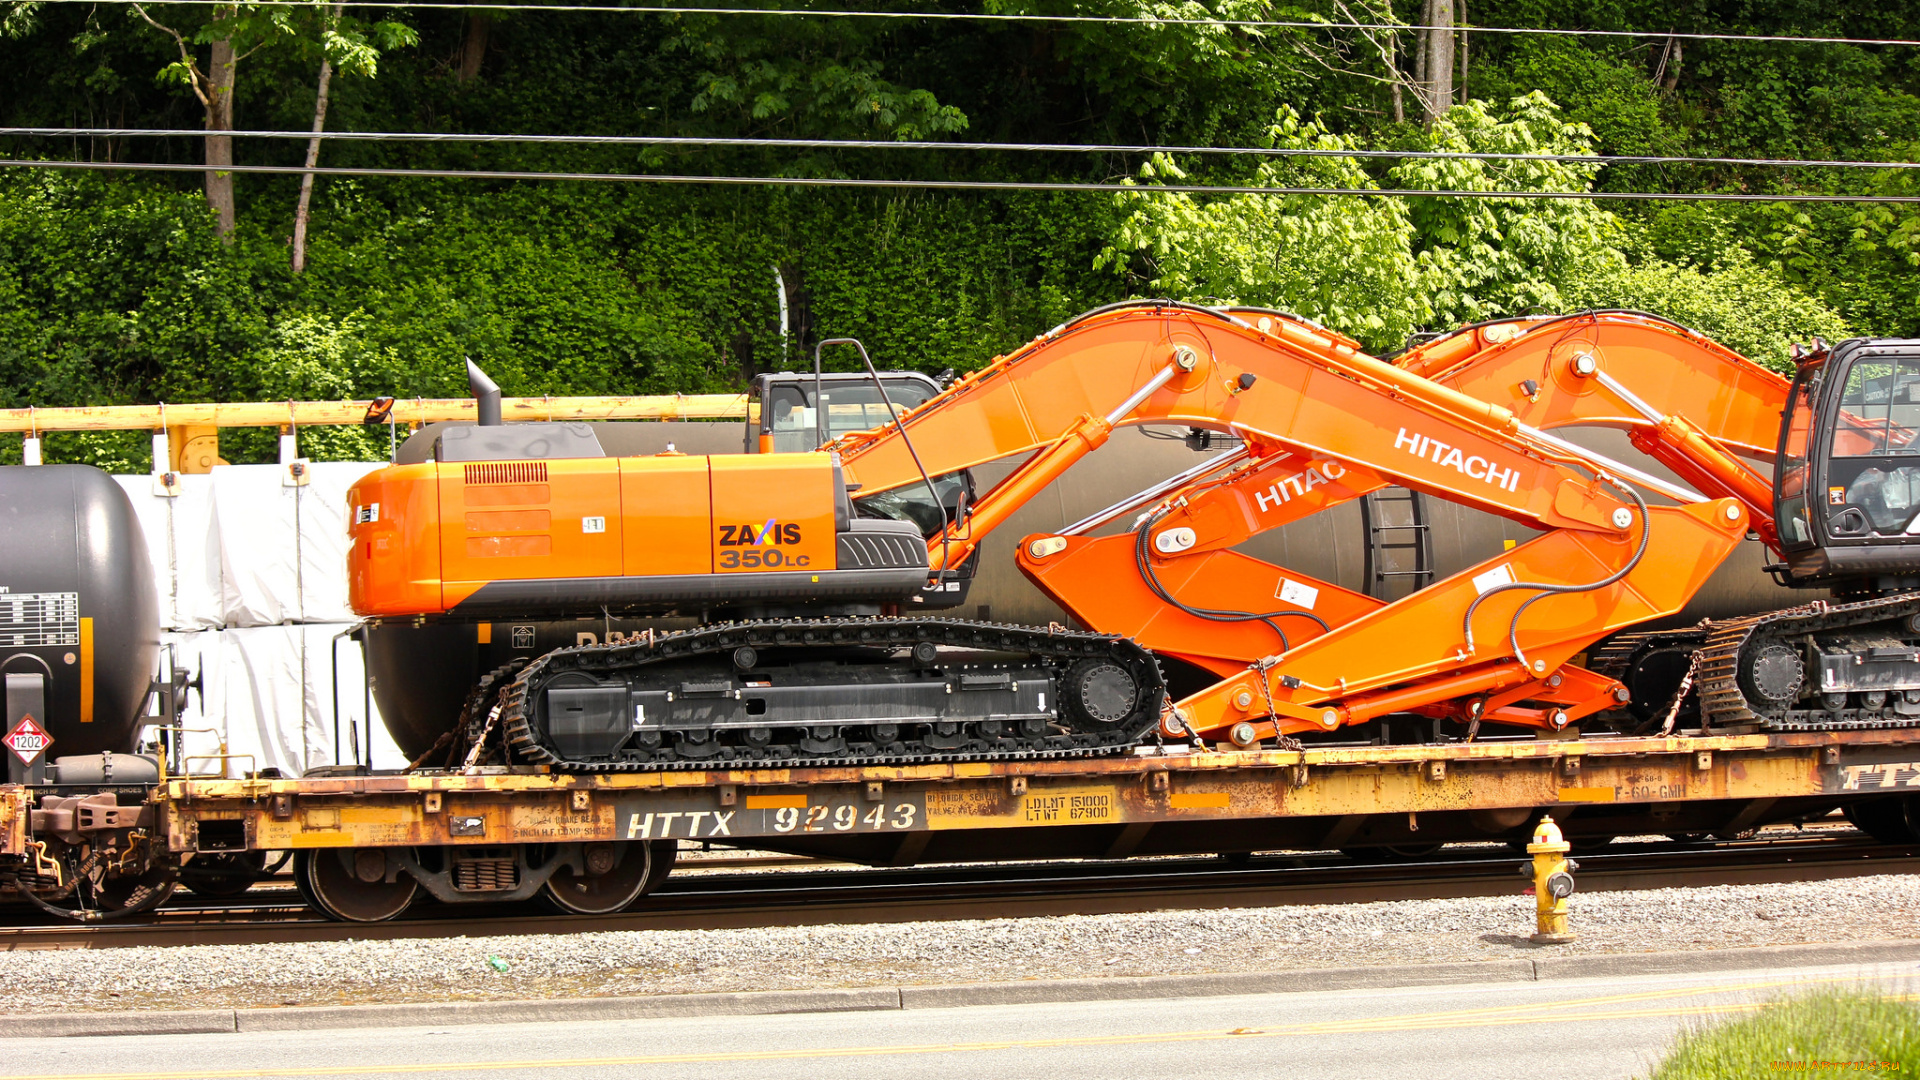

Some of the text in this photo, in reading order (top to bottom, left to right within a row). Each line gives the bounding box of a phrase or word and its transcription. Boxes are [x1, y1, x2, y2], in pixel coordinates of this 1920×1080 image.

[1394, 427, 1520, 492] HITACHI
[1254, 460, 1346, 512] HITAC
[719, 519, 801, 546] ZAXIS
[15, 736, 41, 748] 1202
[1071, 795, 1108, 808] 151000
[1071, 807, 1108, 820] 67900
[627, 803, 916, 839] HTTX 92943
